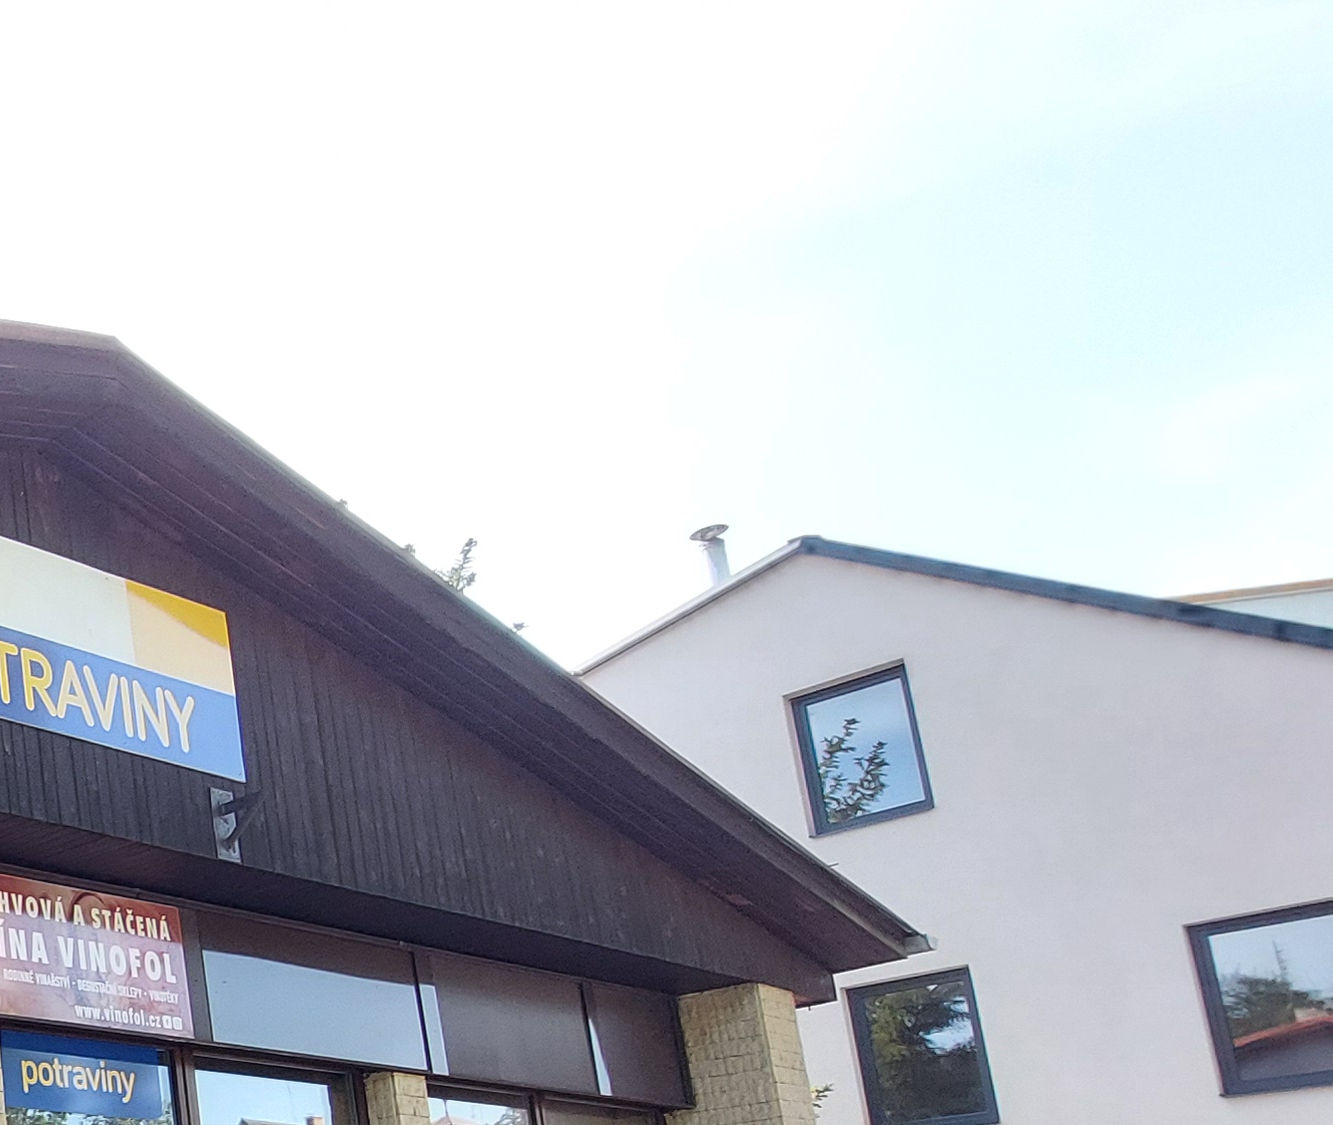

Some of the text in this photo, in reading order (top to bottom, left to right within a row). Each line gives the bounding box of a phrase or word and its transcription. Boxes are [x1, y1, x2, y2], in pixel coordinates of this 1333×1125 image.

[73, 904, 85, 926] A
[91, 907, 171, 941] STÁČENÁ
[57, 936, 177, 984] VINOFOL
[75, 1004, 162, 1028] www.vinofol.cz
[21, 1059, 135, 1104] potraviny
